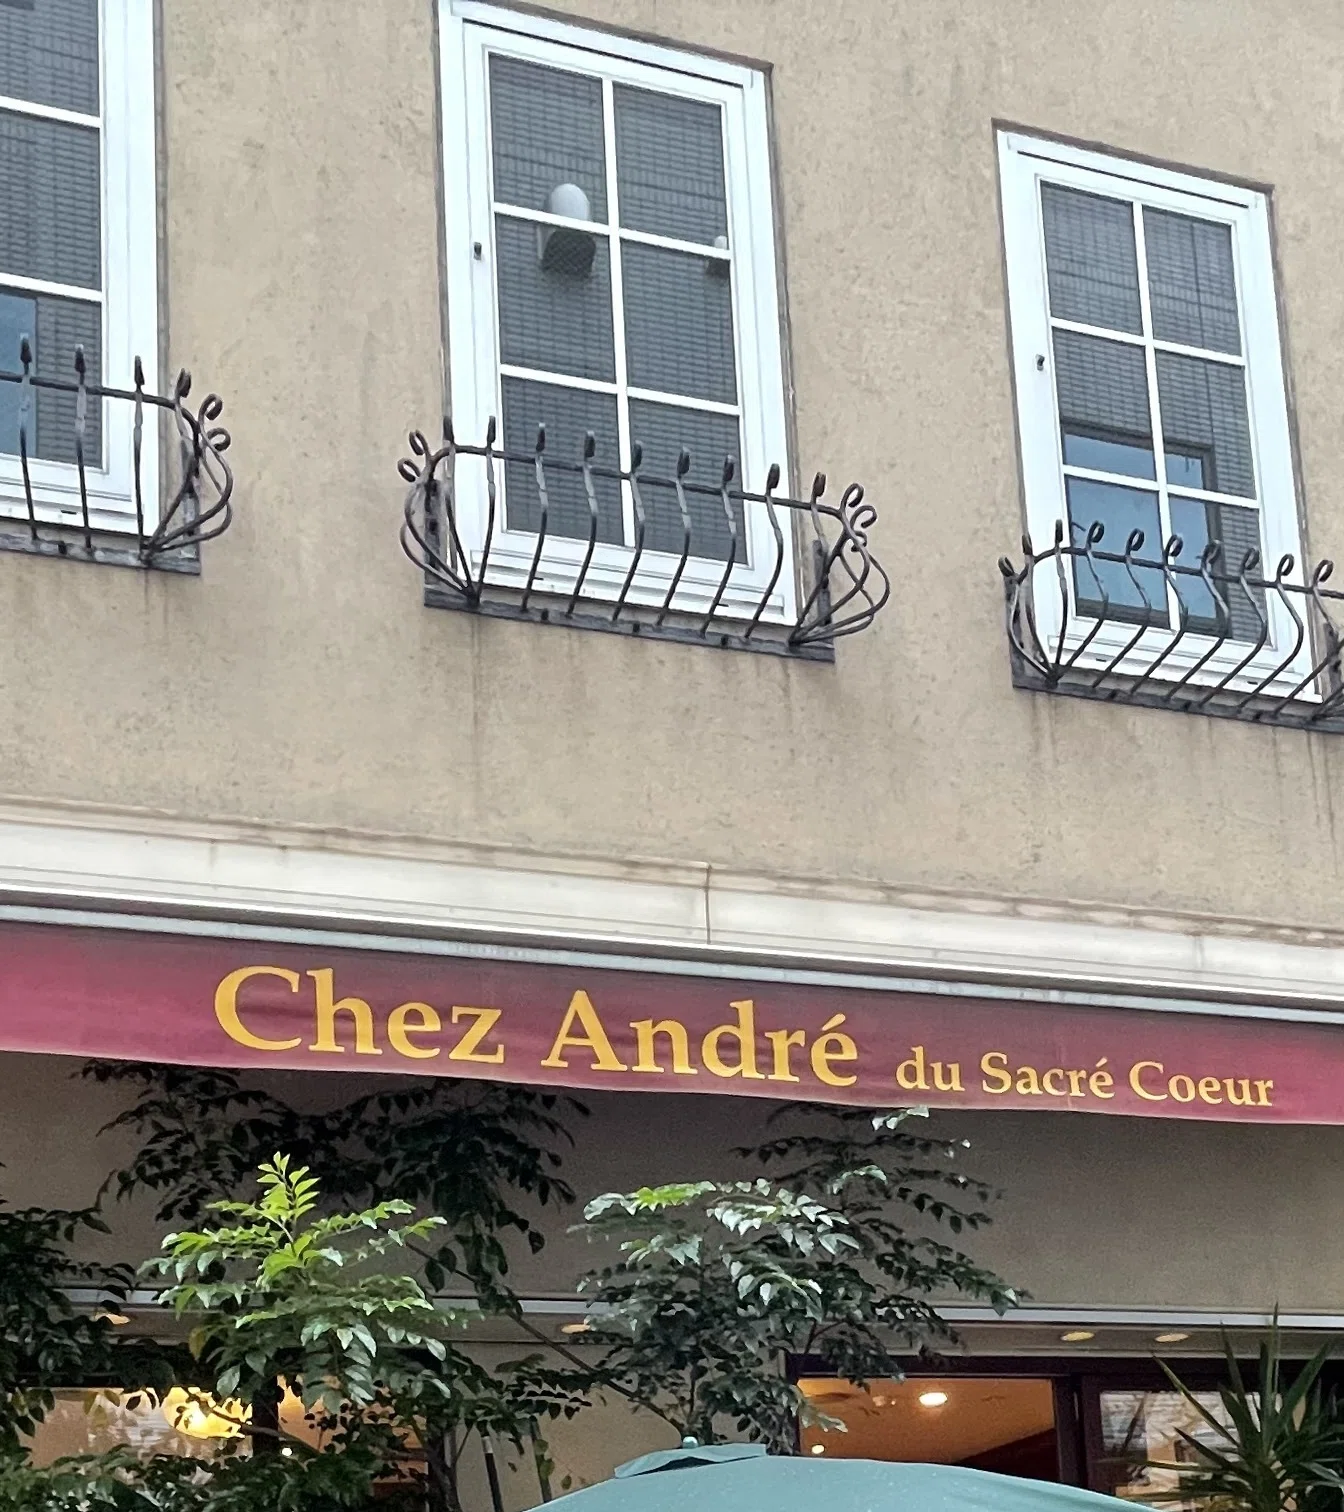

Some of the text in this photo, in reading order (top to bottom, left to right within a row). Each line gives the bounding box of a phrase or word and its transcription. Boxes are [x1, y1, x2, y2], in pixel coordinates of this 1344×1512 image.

[214, 965, 1274, 1107] Chez André du Sacré Coeur
